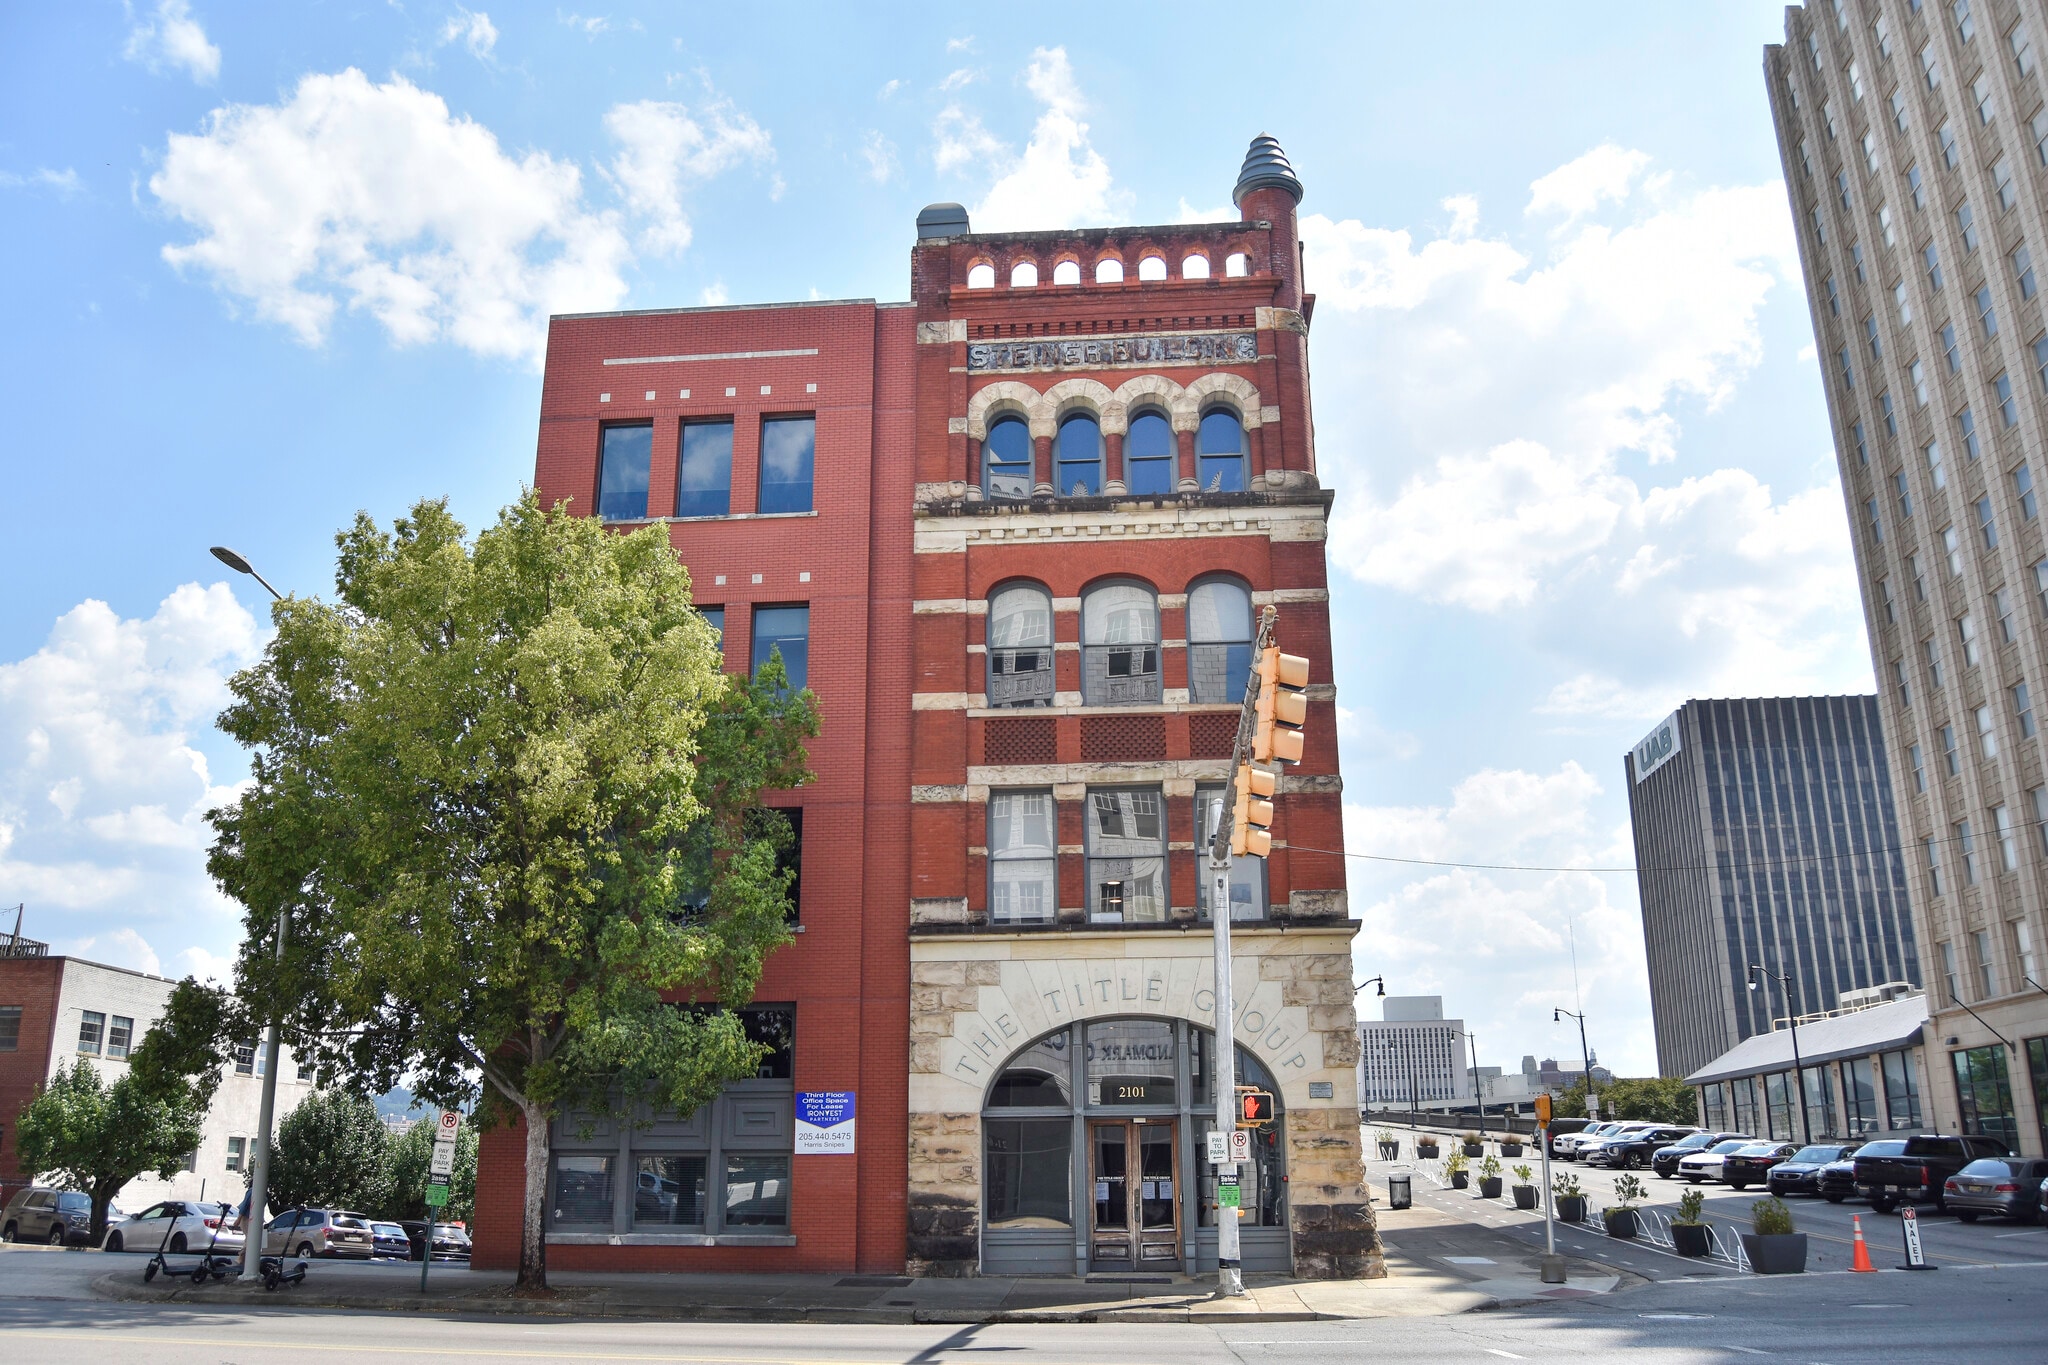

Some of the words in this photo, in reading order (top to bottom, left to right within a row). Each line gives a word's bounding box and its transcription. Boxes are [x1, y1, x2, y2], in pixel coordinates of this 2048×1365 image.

[970, 343, 1101, 368] STEINER
[1112, 335, 1256, 362] BUILDING
[1639, 726, 1673, 773] UAB
[955, 1013, 1019, 1075] THE
[1043, 978, 1163, 1013] TITLE
[1119, 1086, 1146, 1098] 2101
[1907, 1222, 1919, 1262] VALET
